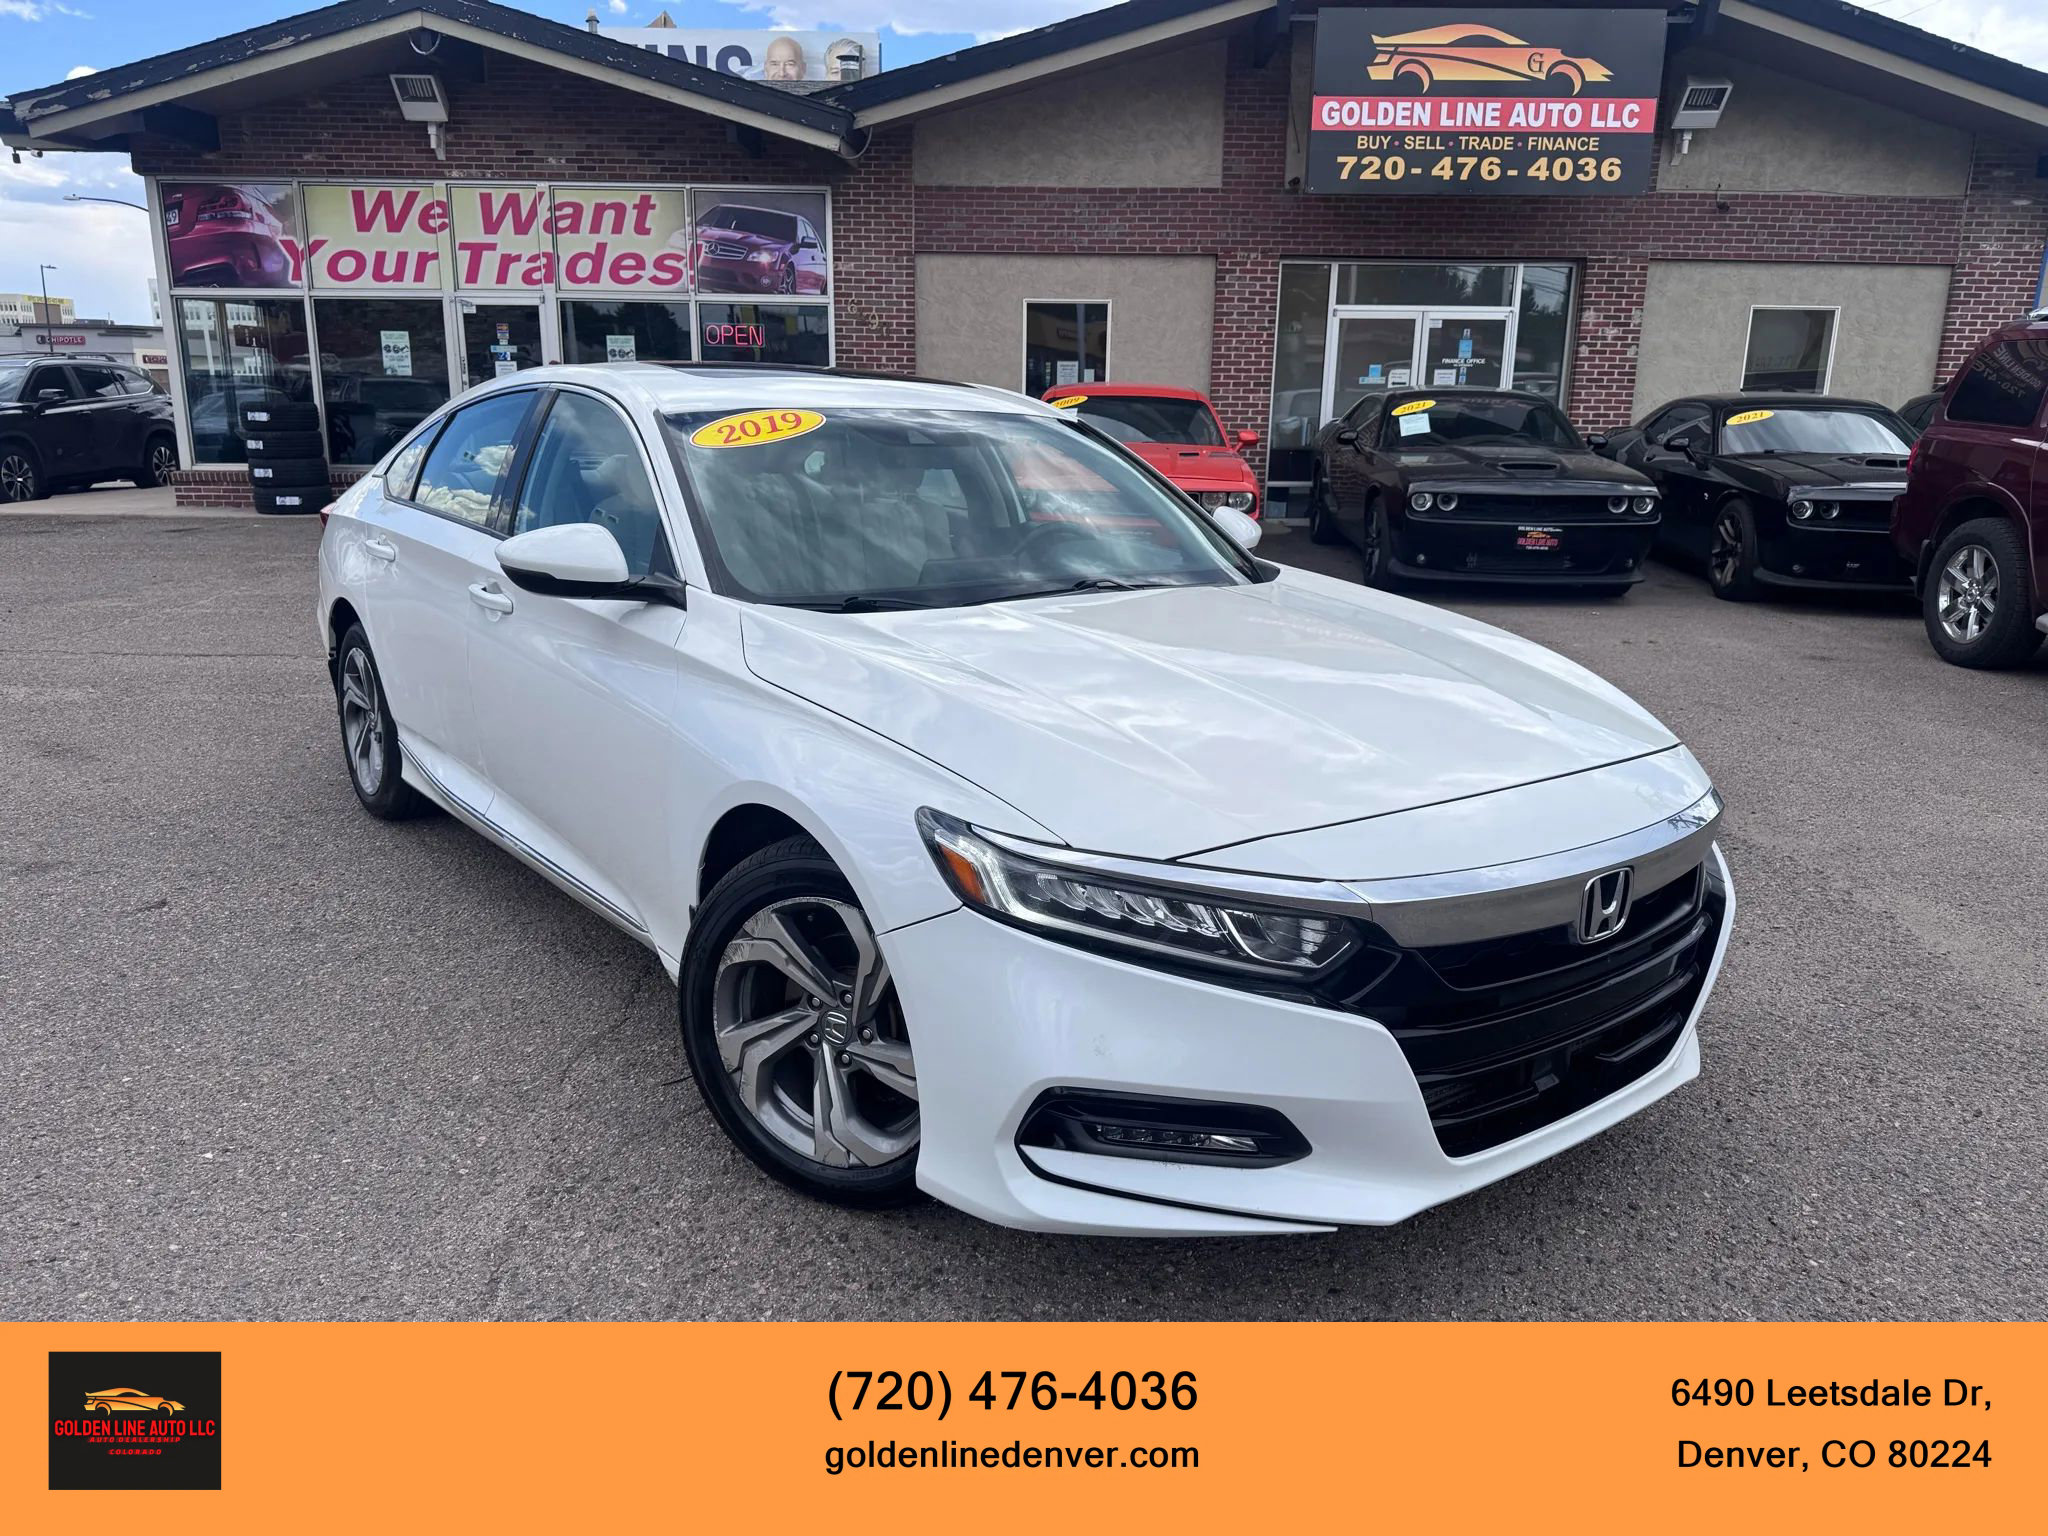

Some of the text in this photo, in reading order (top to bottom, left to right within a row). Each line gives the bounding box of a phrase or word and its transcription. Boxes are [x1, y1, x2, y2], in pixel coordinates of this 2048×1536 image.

[1321, 101, 1641, 129] GOLDEN LINE AUTO LLC
[1356, 135, 1600, 151] BUY SELL TRADE FINANCE
[351, 189, 657, 236] We Want
[279, 239, 704, 286] Your Trades!
[46, 336, 82, 344] CHIPOTLE
[705, 325, 764, 346] OPEN
[1401, 402, 1427, 413] 2021
[1737, 412, 1763, 423] 2021
[716, 412, 802, 444] 2019
